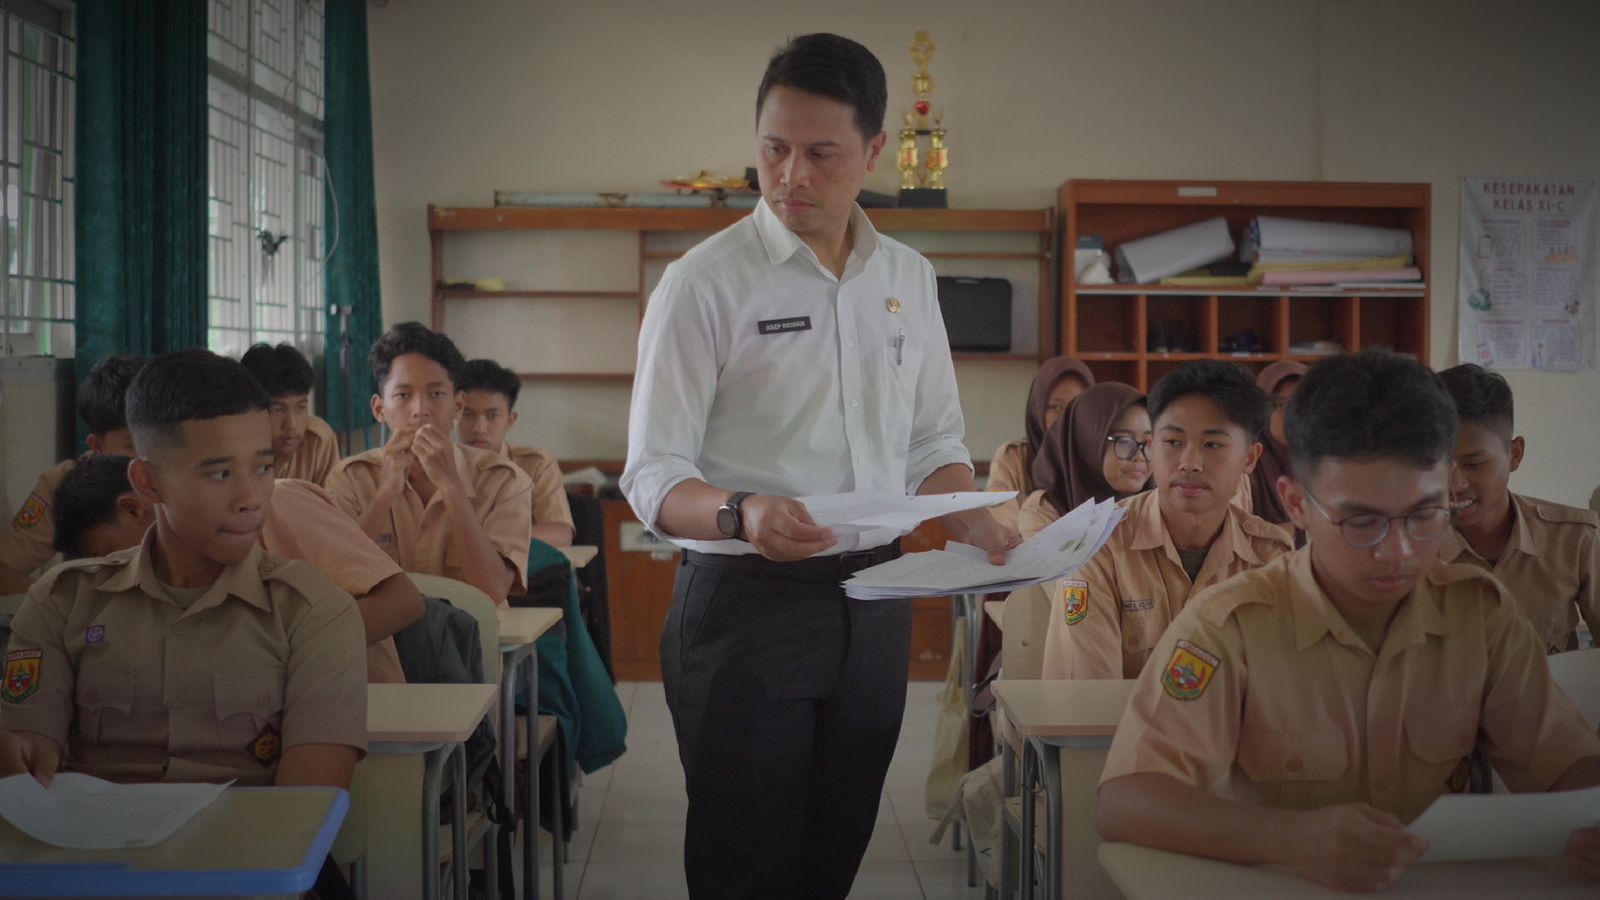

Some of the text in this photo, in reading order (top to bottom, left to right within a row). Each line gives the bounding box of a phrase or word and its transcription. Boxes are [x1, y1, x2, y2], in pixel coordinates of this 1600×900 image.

[1483, 182, 1576, 196] KESEPAKATAN
[1493, 197, 1533, 211] KELAS
[765, 323, 781, 332] ASEP
